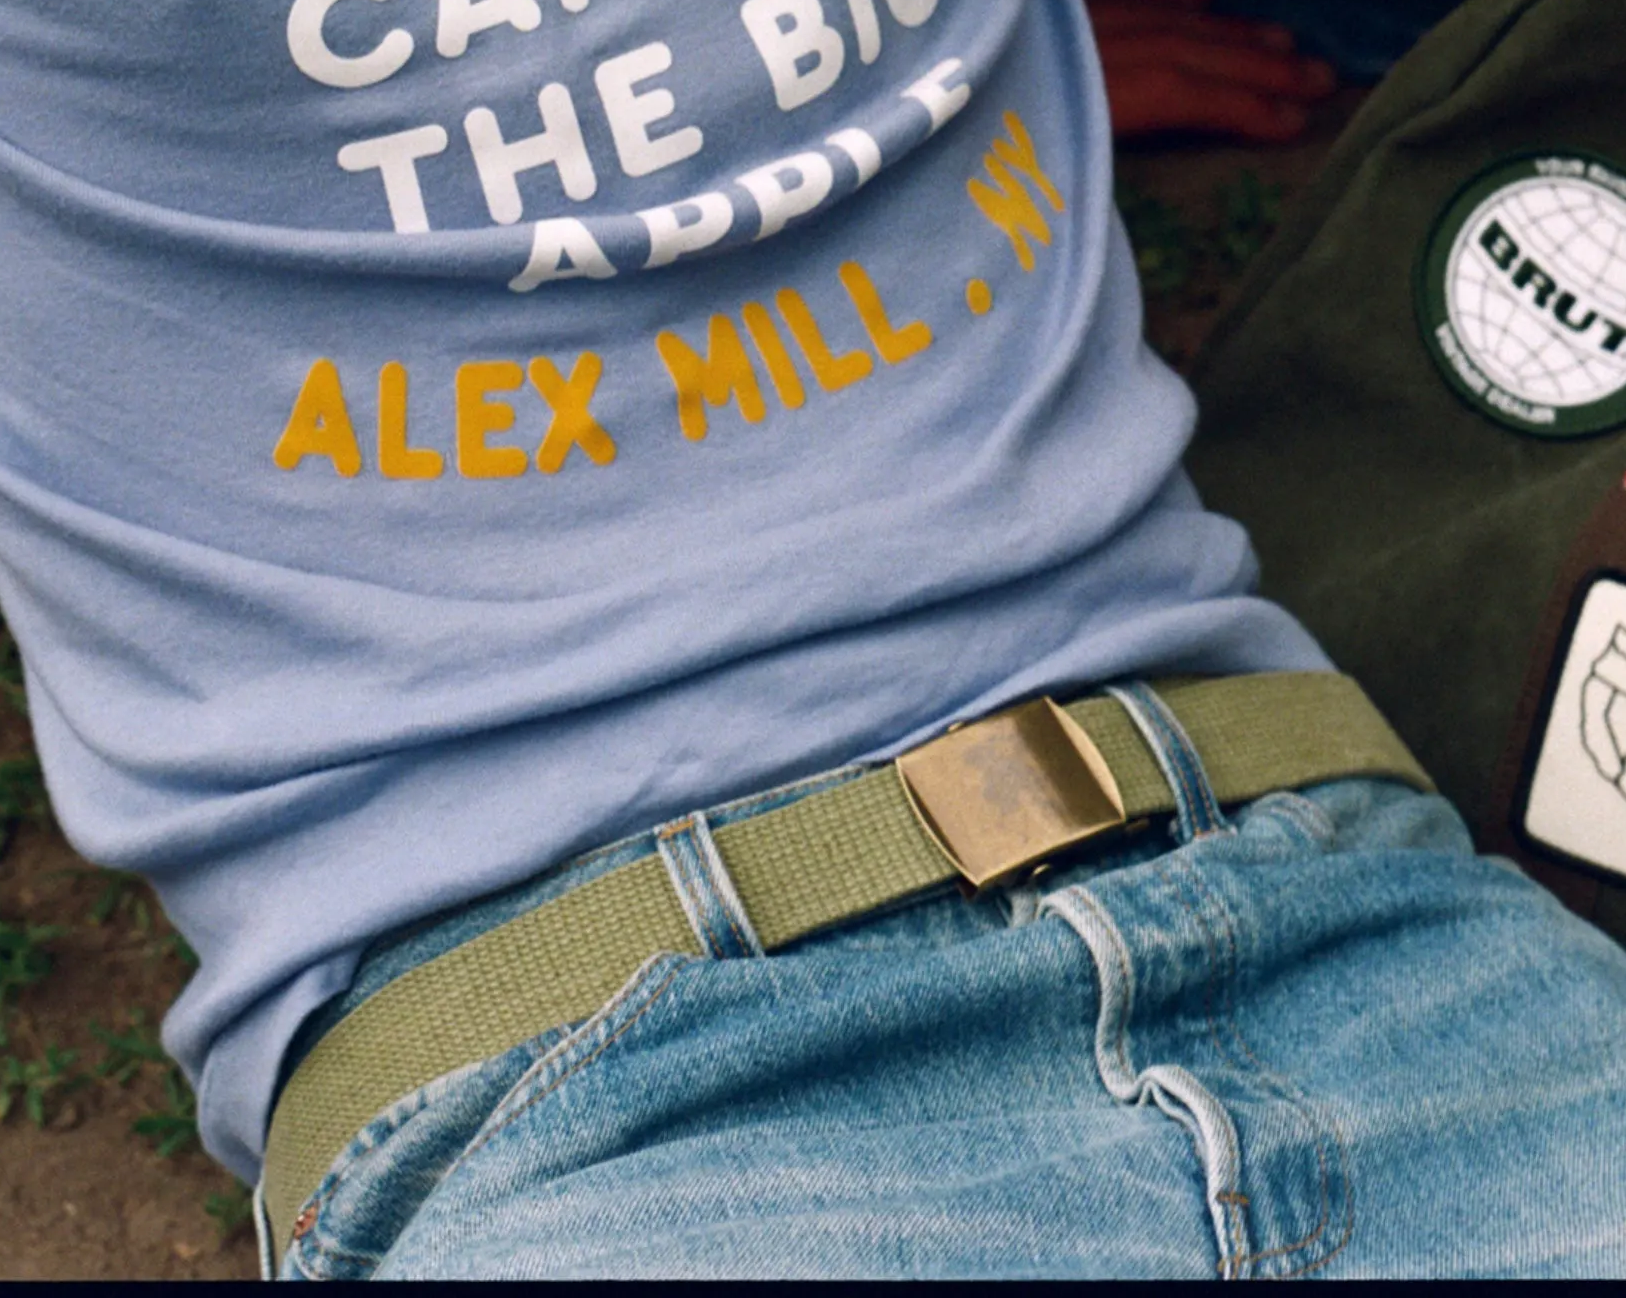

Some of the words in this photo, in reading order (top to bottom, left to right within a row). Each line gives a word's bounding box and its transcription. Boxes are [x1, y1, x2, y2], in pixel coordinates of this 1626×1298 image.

[336, 40, 705, 235] THE
[272, 353, 618, 481] ALEX
[965, 109, 1066, 273] NY
